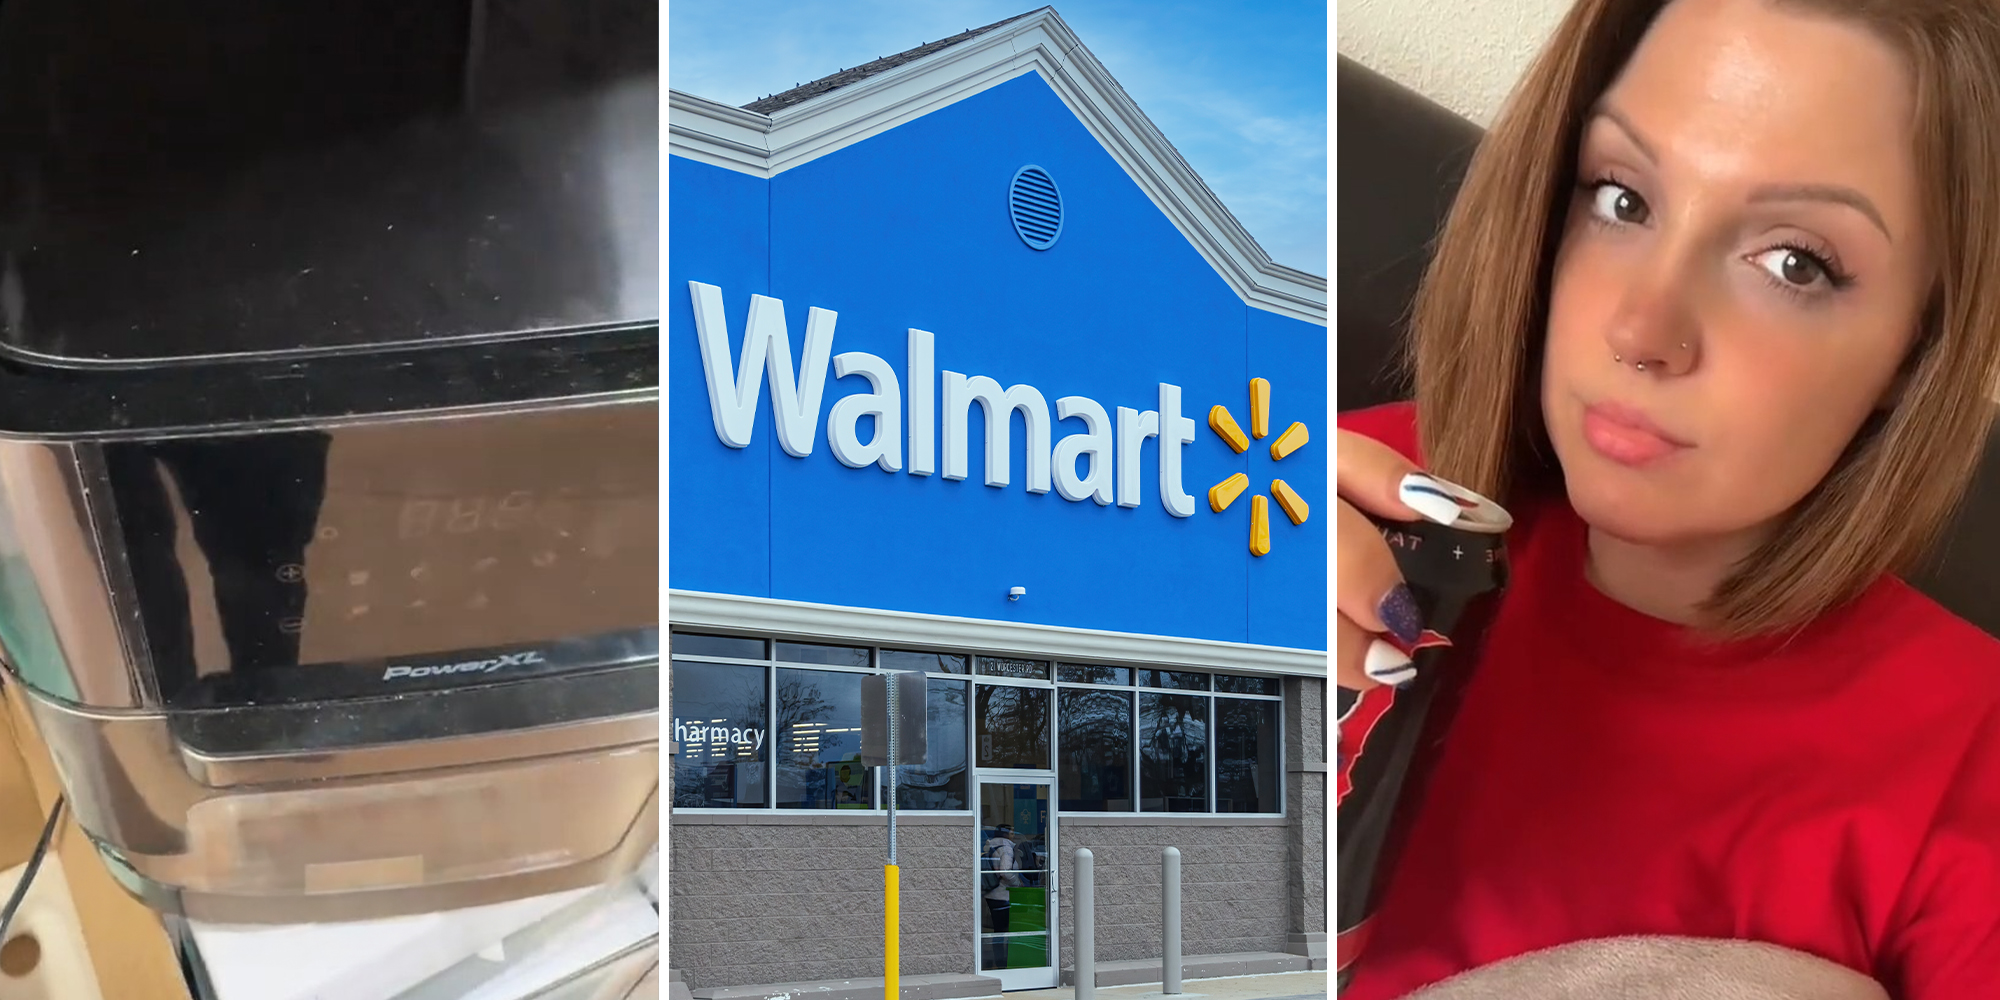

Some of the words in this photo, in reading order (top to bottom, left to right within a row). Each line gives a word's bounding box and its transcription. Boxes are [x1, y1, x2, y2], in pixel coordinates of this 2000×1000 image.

[689, 280, 1196, 518] Walmart
[382, 651, 545, 681] PowerXL
[997, 662, 1025, 673] WORCESTER
[672, 718, 765, 751] harmacy
